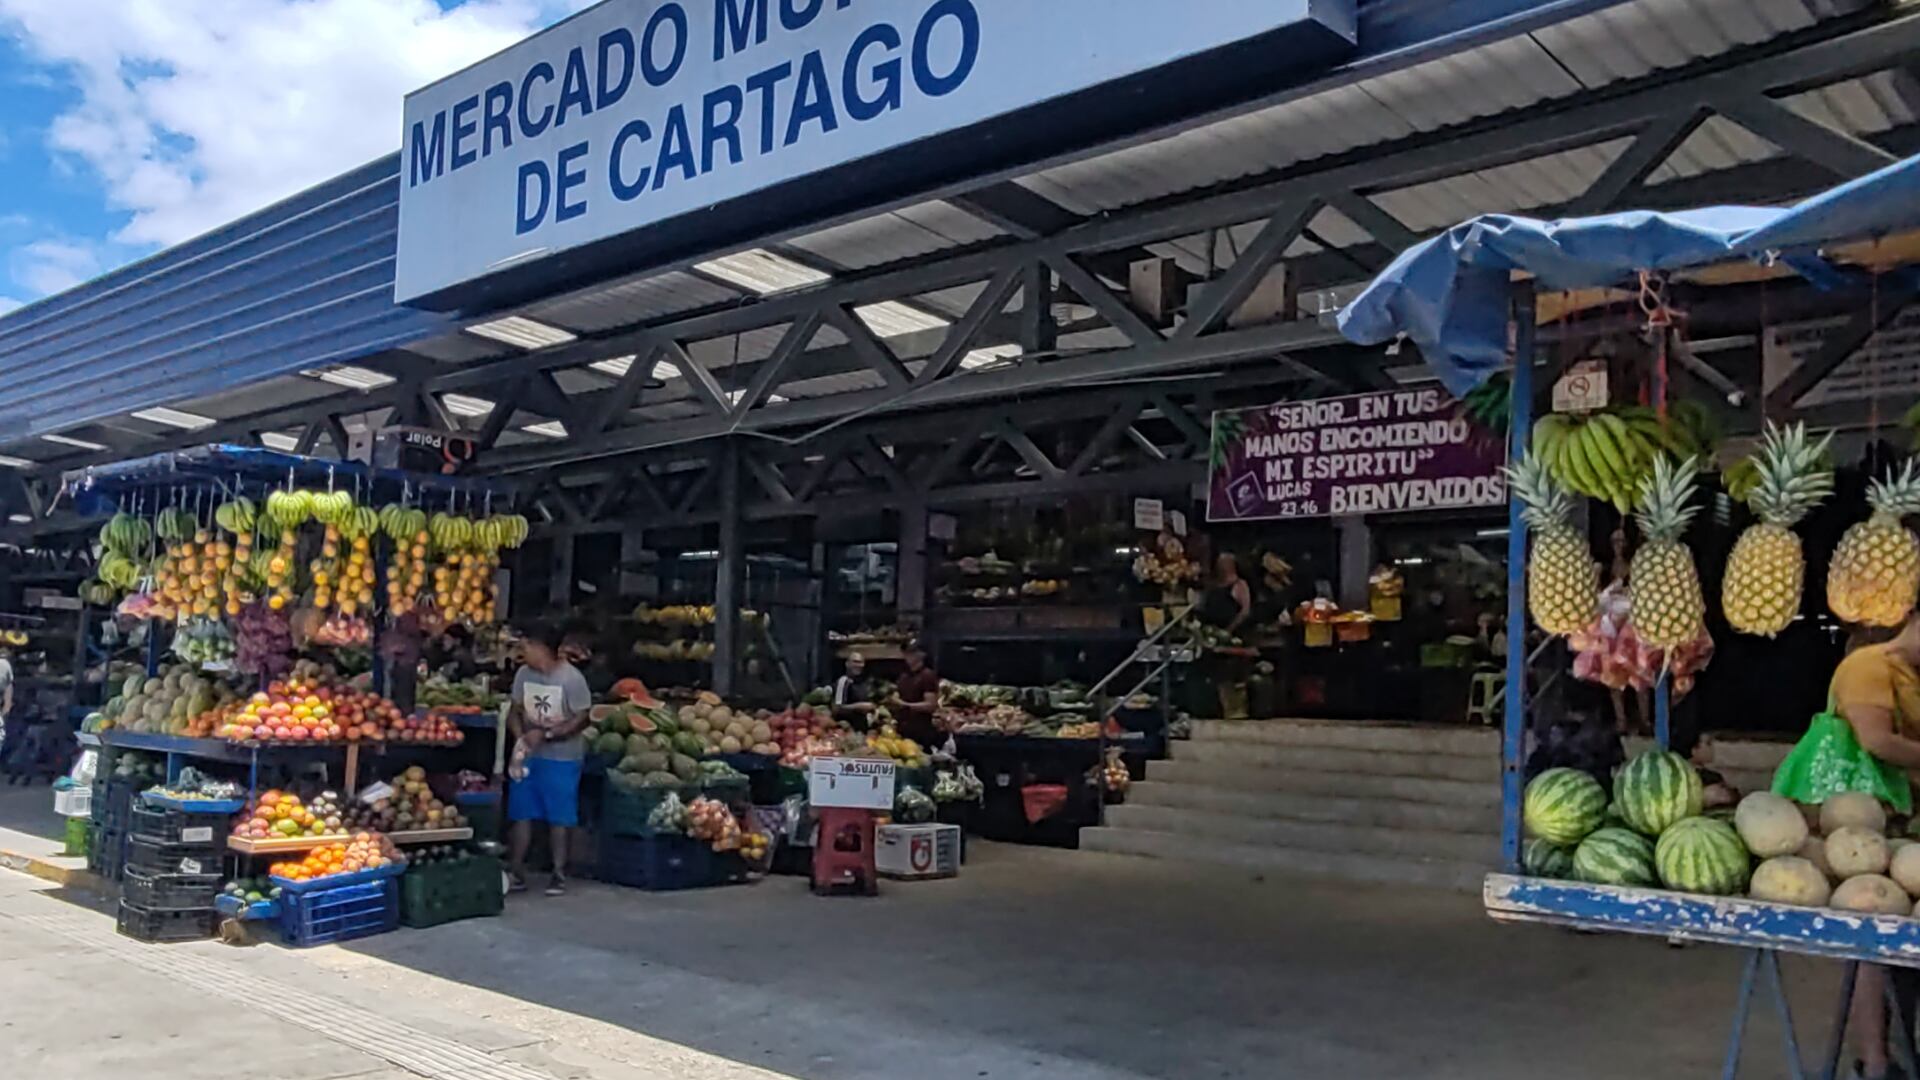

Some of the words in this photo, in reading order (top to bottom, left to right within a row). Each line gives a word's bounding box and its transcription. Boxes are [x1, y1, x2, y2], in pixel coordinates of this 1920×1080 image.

[410, 3, 688, 188] MERCADO
[516, 141, 589, 236] DE
[609, 0, 980, 201] CARTAGO
[1394, 389, 1439, 416] TUS
[406, 432, 442, 448] Polar
[1245, 431, 1315, 459] MANOS
[1320, 418, 1470, 452] ENCOMIENDO
[1265, 459, 1294, 483] MI
[1267, 481, 1312, 501] LUCAS
[1331, 475, 1504, 513] BIENVENIDOS
